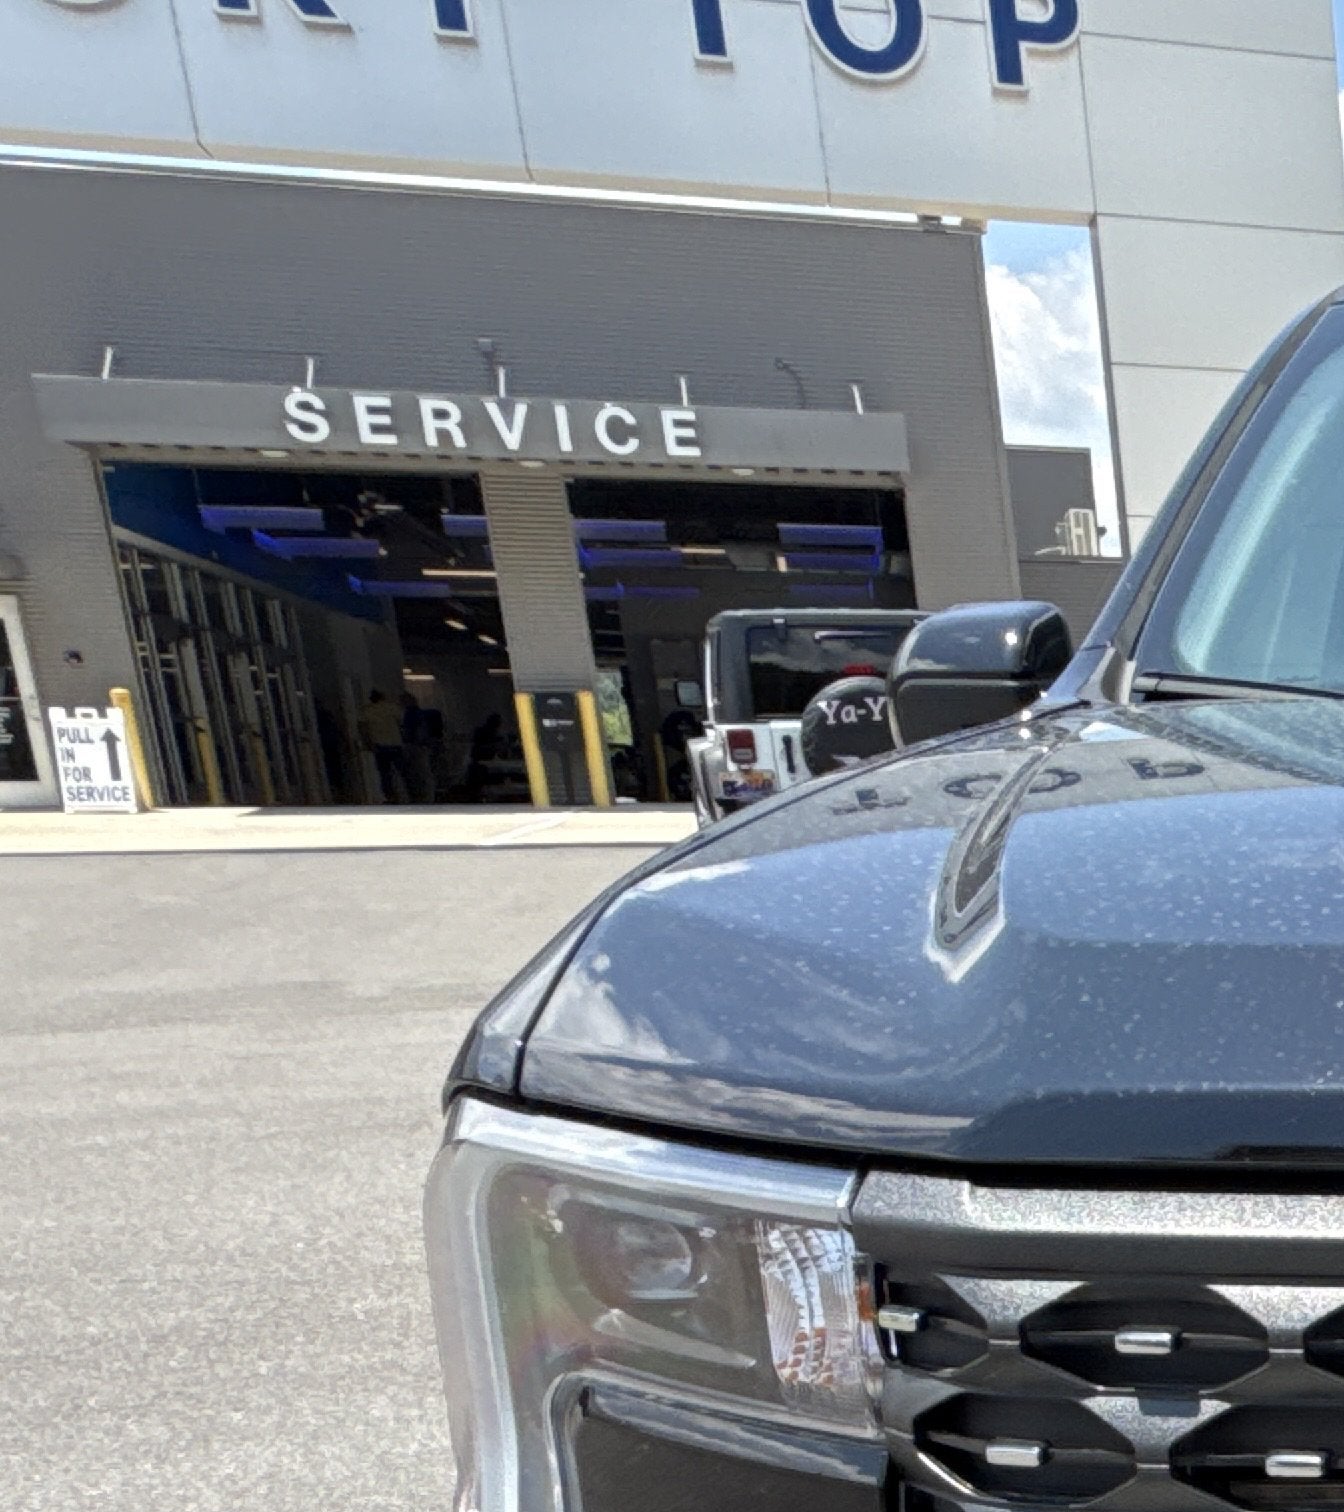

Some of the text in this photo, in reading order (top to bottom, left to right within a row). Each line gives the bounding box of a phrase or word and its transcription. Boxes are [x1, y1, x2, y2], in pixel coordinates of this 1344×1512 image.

[283, 391, 702, 456] SERVICE
[817, 696, 889, 726] Ya-Y
[56, 727, 95, 744] PULL
[60, 747, 76, 763] IN
[63, 766, 93, 783] FOR
[66, 785, 131, 802] SERVICE
